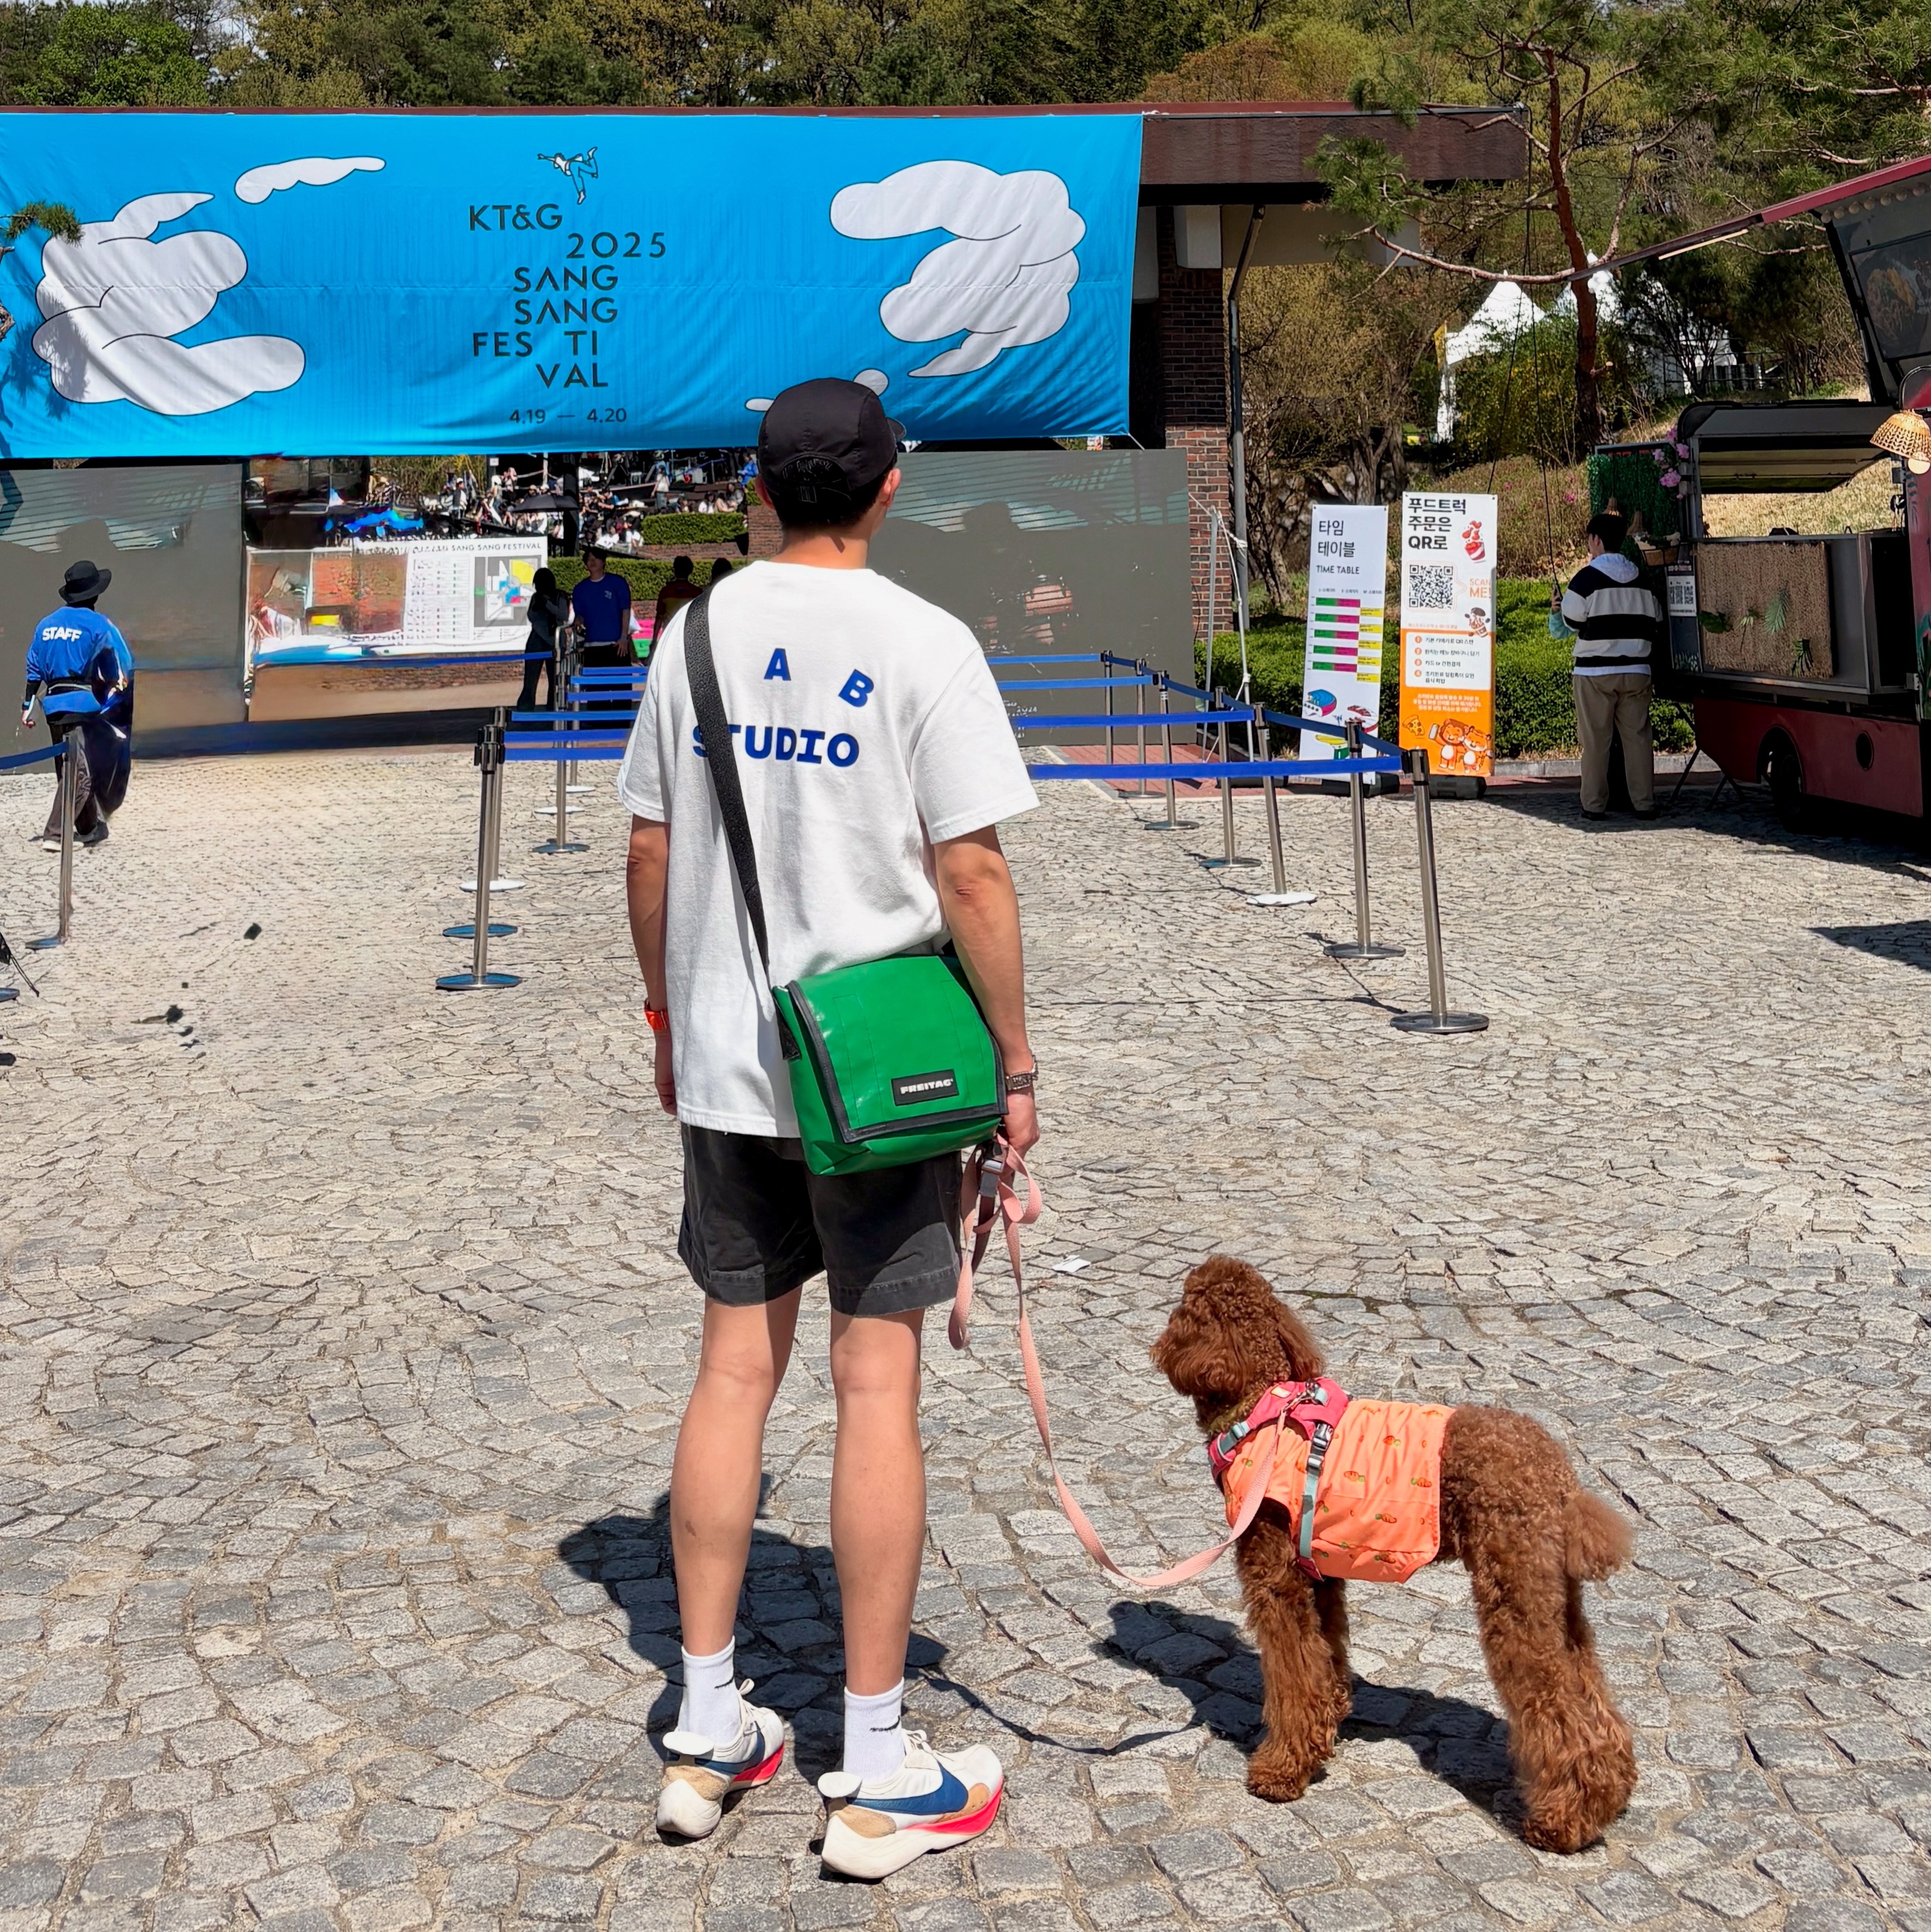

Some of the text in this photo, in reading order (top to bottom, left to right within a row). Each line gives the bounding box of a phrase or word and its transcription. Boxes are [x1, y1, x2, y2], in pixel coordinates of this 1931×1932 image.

[469, 204, 563, 231] KT&G
[566, 232, 666, 259] 2025
[513, 264, 619, 292] SANG
[514, 297, 619, 325] SANG
[472, 330, 598, 357] FES TI
[535, 363, 609, 388] VAL
[509, 409, 546, 424] 4.19
[586, 408, 627, 423] 4.20
[1408, 498, 1467, 515] 푸드트럭
[1319, 520, 1344, 536] 타임
[1408, 516, 1453, 532] 주문은
[1317, 541, 1356, 558] 테이블
[1408, 535, 1448, 550] QR로
[1316, 565, 1360, 574] TIME TABLE
[1469, 578, 1492, 586] SCAN
[1469, 587, 1492, 599] ME!
[42, 626, 83, 642] STAFF
[763, 647, 875, 708] A B
[899, 1078, 953, 1095] FREITAG
